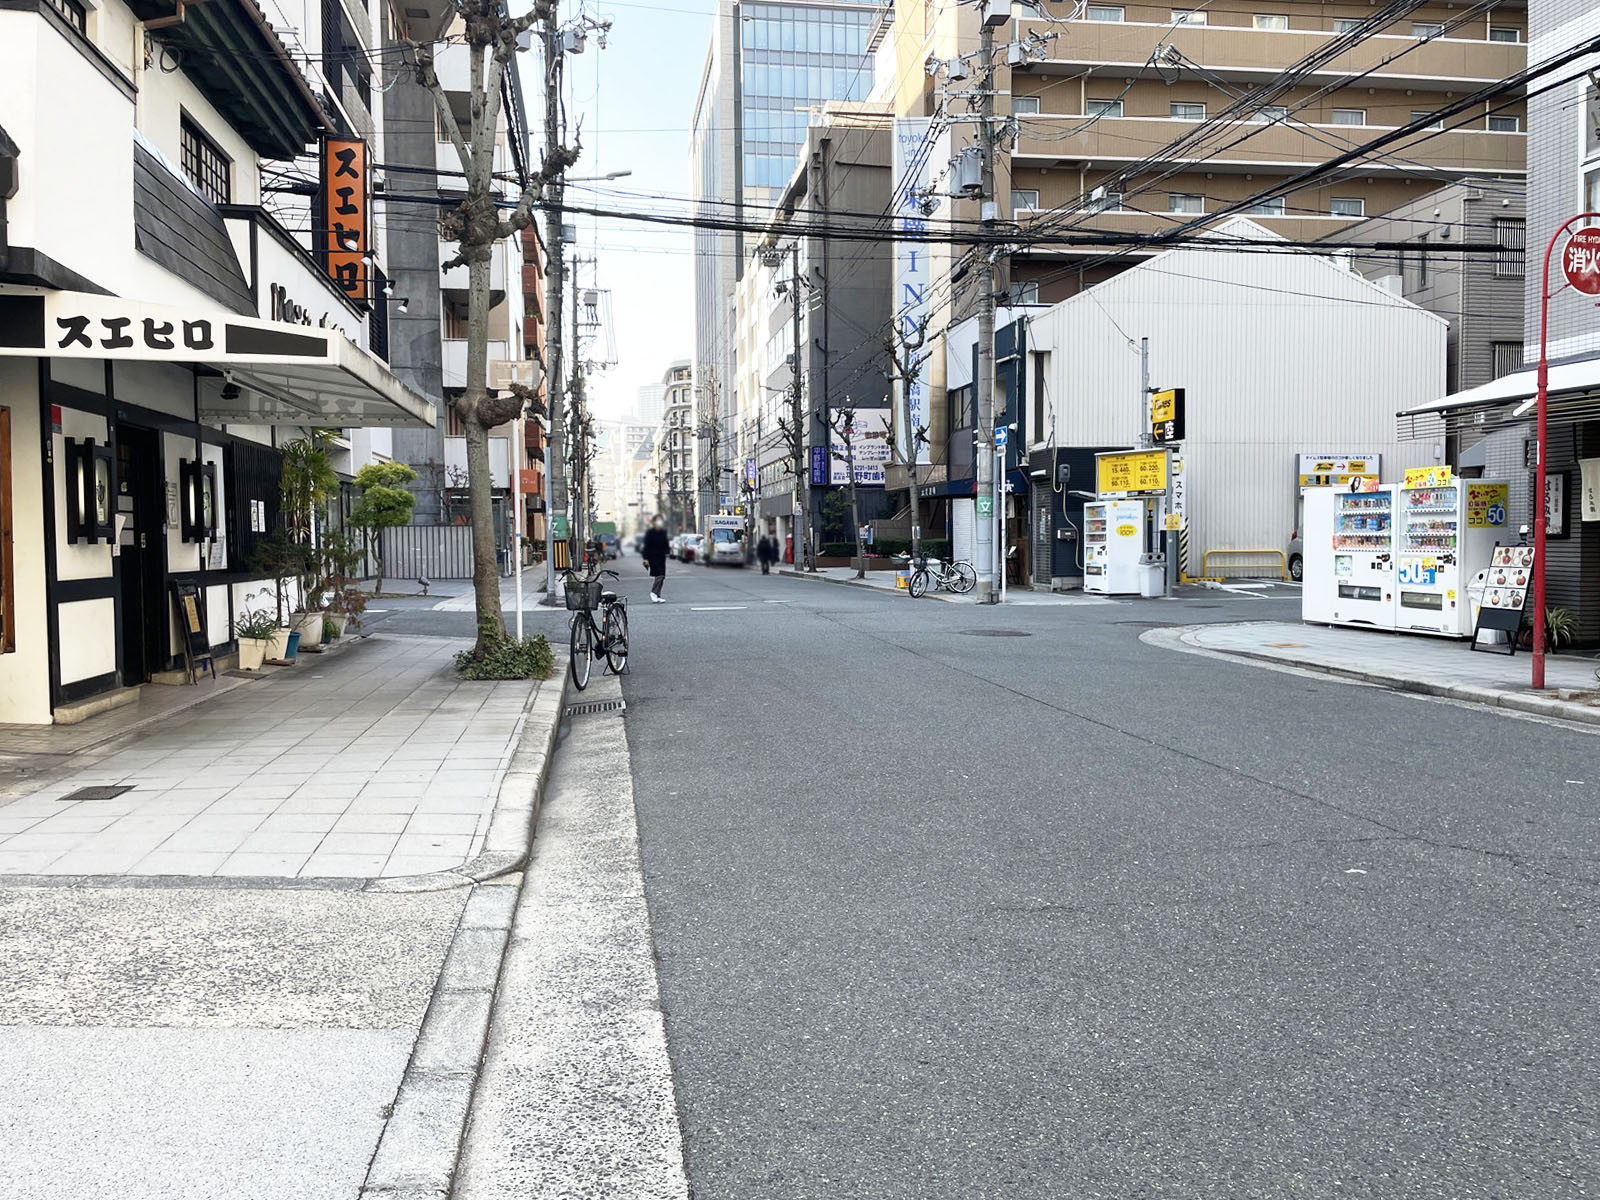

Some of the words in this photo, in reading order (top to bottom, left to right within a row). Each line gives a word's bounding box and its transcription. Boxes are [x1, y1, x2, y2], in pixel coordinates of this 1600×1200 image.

[332, 147, 361, 292] スエヒロ
[1573, 234, 1587, 243] FIRE
[1567, 246, 1600, 274] 消火
[56, 315, 214, 350] スエヒロ
[1488, 508, 1505, 523] 50
